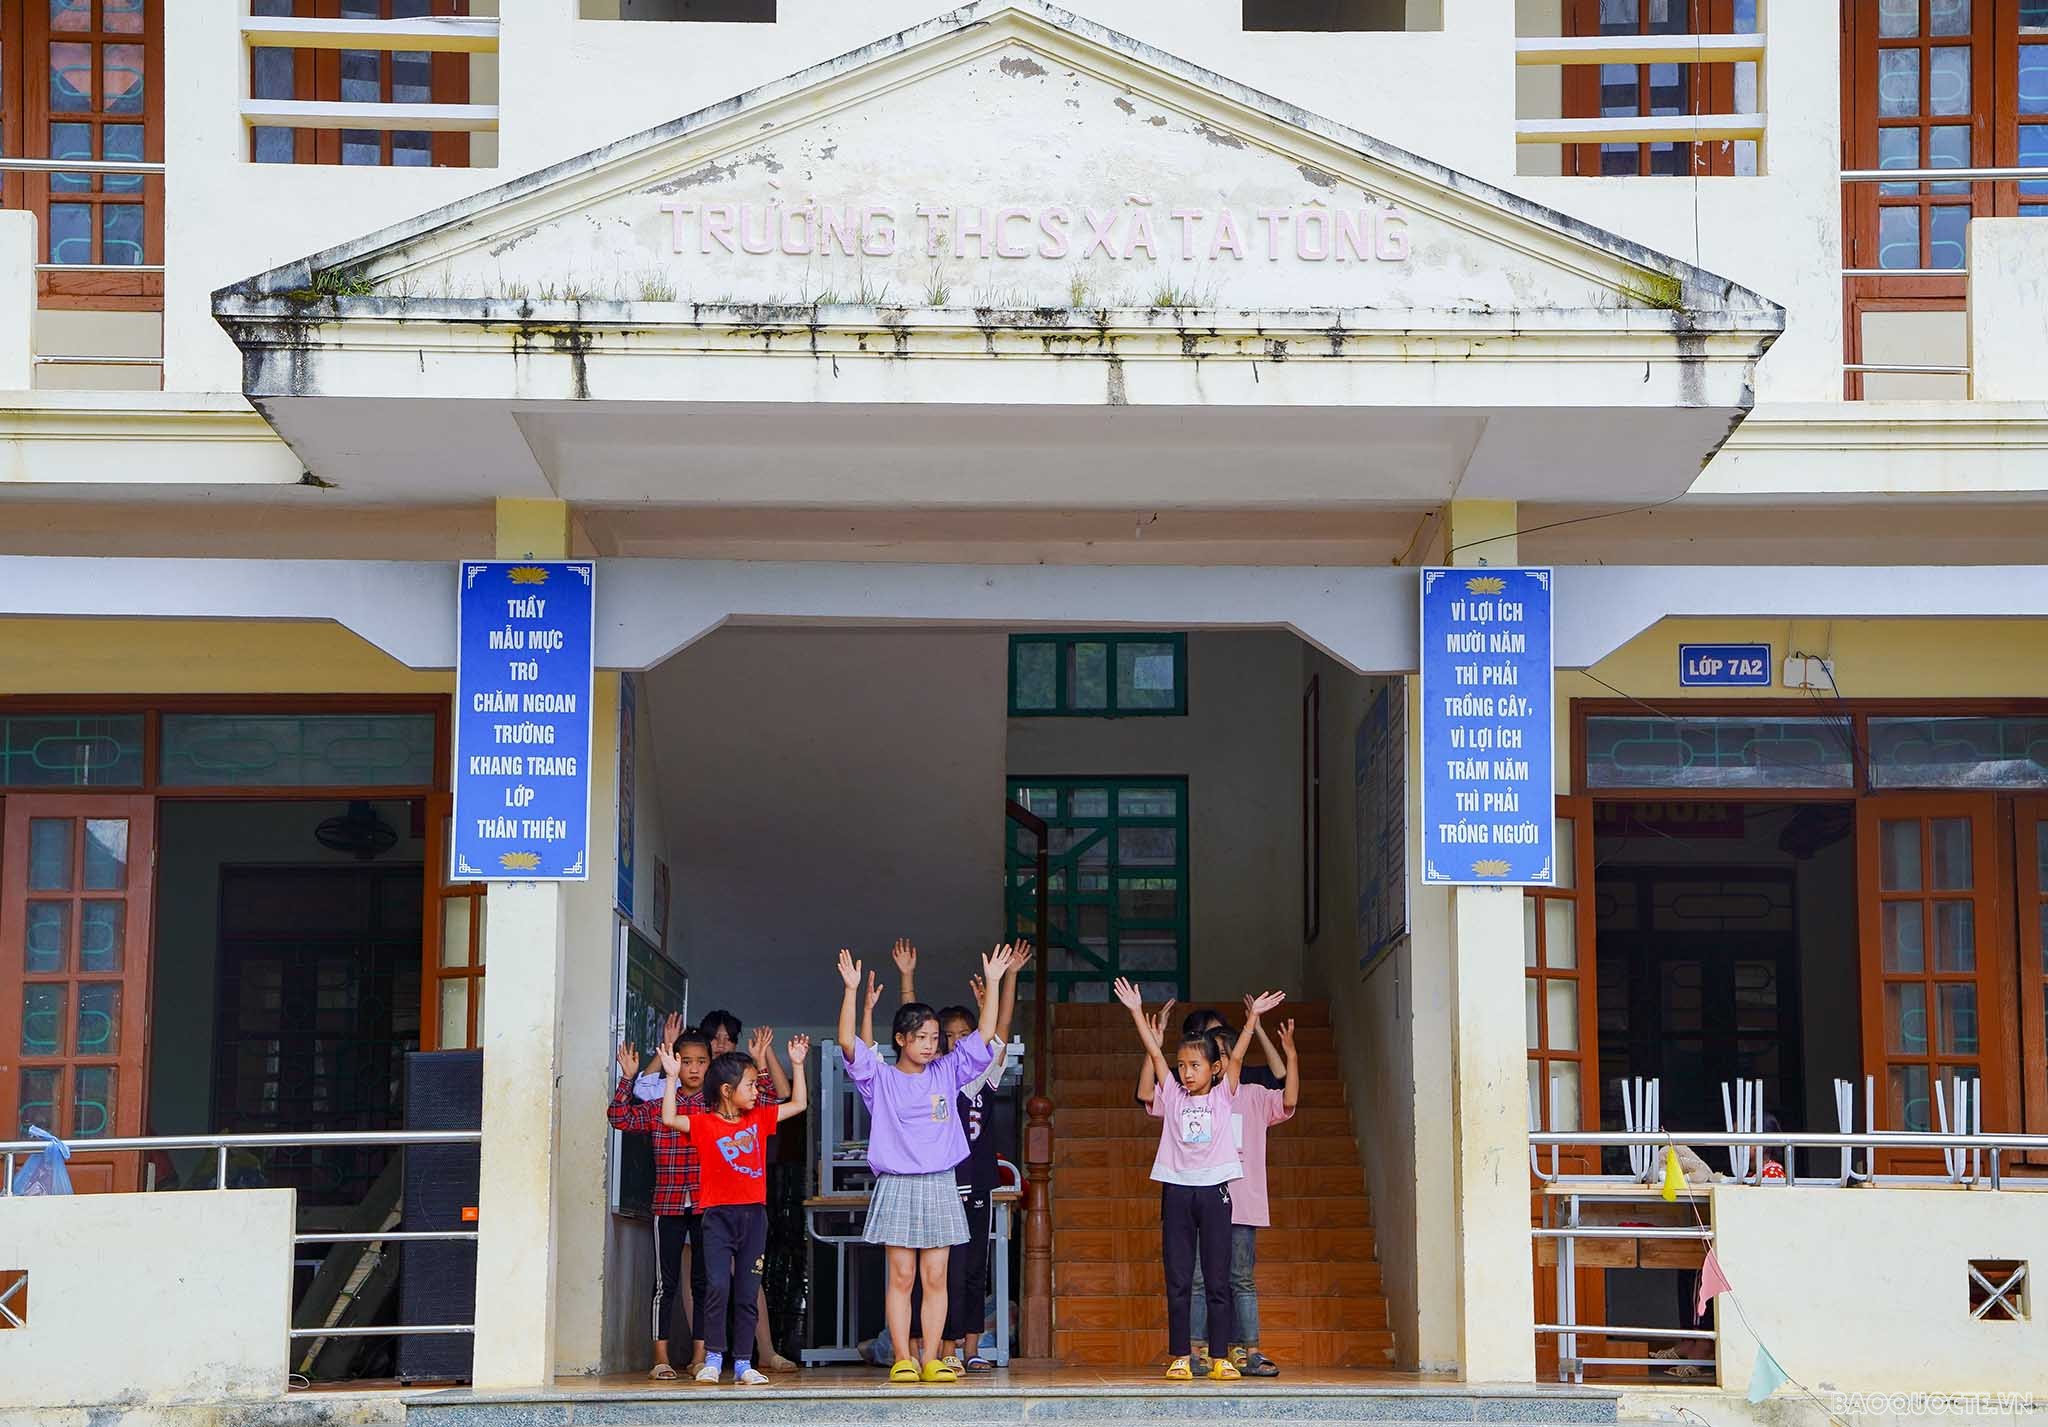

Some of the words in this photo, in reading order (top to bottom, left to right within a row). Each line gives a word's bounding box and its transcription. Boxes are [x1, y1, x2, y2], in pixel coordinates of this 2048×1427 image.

[916, 202, 1069, 259] THCS
[1083, 192, 1157, 260] XÃ
[507, 595, 546, 618] THẦY
[1451, 599, 1466, 621] VÌ
[1470, 600, 1492, 625] LỢI
[1497, 599, 1523, 622] ÍCH
[489, 624, 523, 649] MẪU
[529, 628, 563, 653] MỰC
[1447, 630, 1485, 653] MƯỜI
[1490, 631, 1525, 653] NĂM
[509, 658, 538, 681] TRÒ
[1455, 662, 1478, 685] THÌ
[1482, 659, 1518, 685] PHẢI
[1689, 656, 1723, 675] LỚP
[1728, 660, 1763, 675] 7A2
[473, 690, 518, 713] CHĂM
[523, 694, 576, 713] NGOAN
[1444, 692, 1493, 717] TRỒNG
[1498, 693, 1533, 717] CÂY,
[494, 721, 555, 744] TRƯỜNG
[1451, 726, 1465, 748] VÌ
[1469, 727, 1492, 752] LỢI
[1497, 725, 1522, 748] ÍCH
[470, 757, 522, 776] KHANG
[527, 757, 577, 776] TRANG
[1447, 757, 1489, 780] TRĂM
[1493, 757, 1528, 780] NĂM
[505, 784, 535, 807] LỚP
[1456, 789, 1480, 811] THÌ
[1484, 787, 1519, 812] PHẢI
[477, 816, 517, 838] THÂN
[522, 816, 567, 843] THIỆN
[1439, 818, 1488, 843] TRỒNG
[1493, 821, 1539, 844] NGƯỜI
